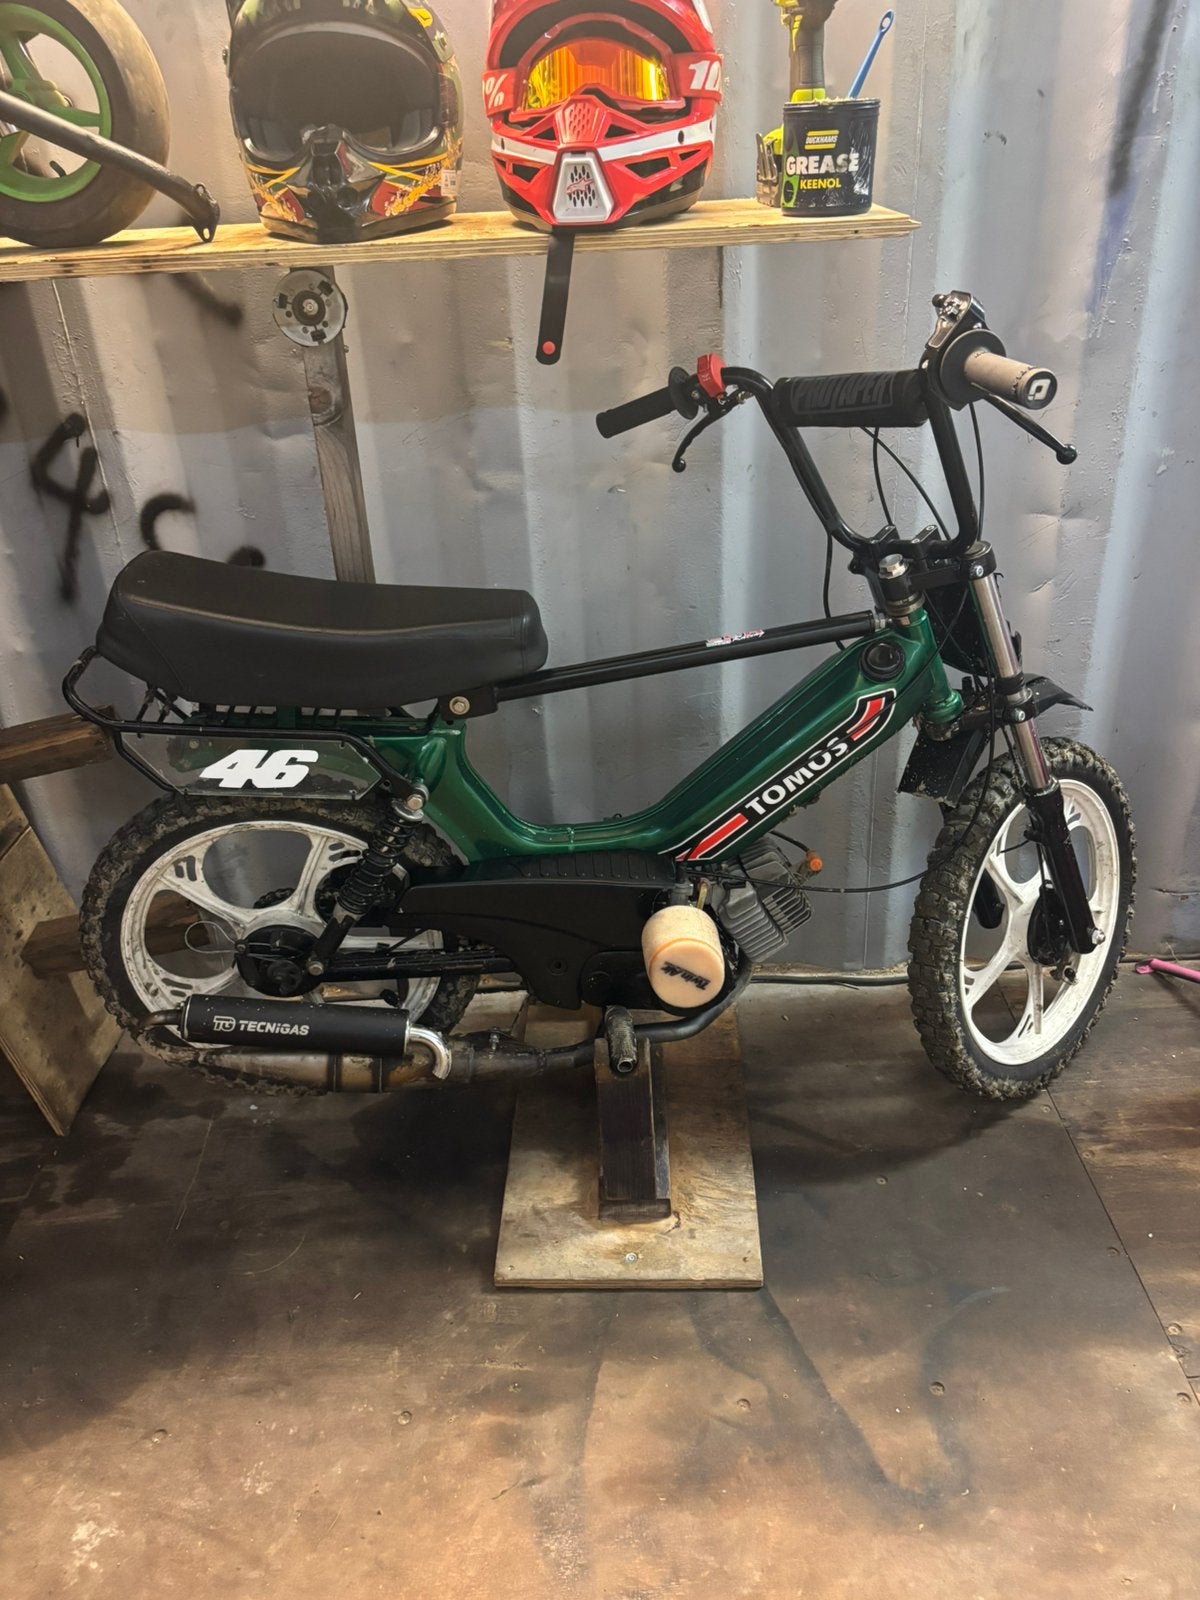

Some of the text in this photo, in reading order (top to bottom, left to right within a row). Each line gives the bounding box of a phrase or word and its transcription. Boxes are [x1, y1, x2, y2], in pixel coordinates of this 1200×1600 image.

[805, 134, 839, 145] DUCKHAMS
[786, 152, 860, 176] GREASE
[799, 177, 842, 190] KEENOL
[199, 749, 319, 789] 46
[745, 736, 850, 816] TOMOS
